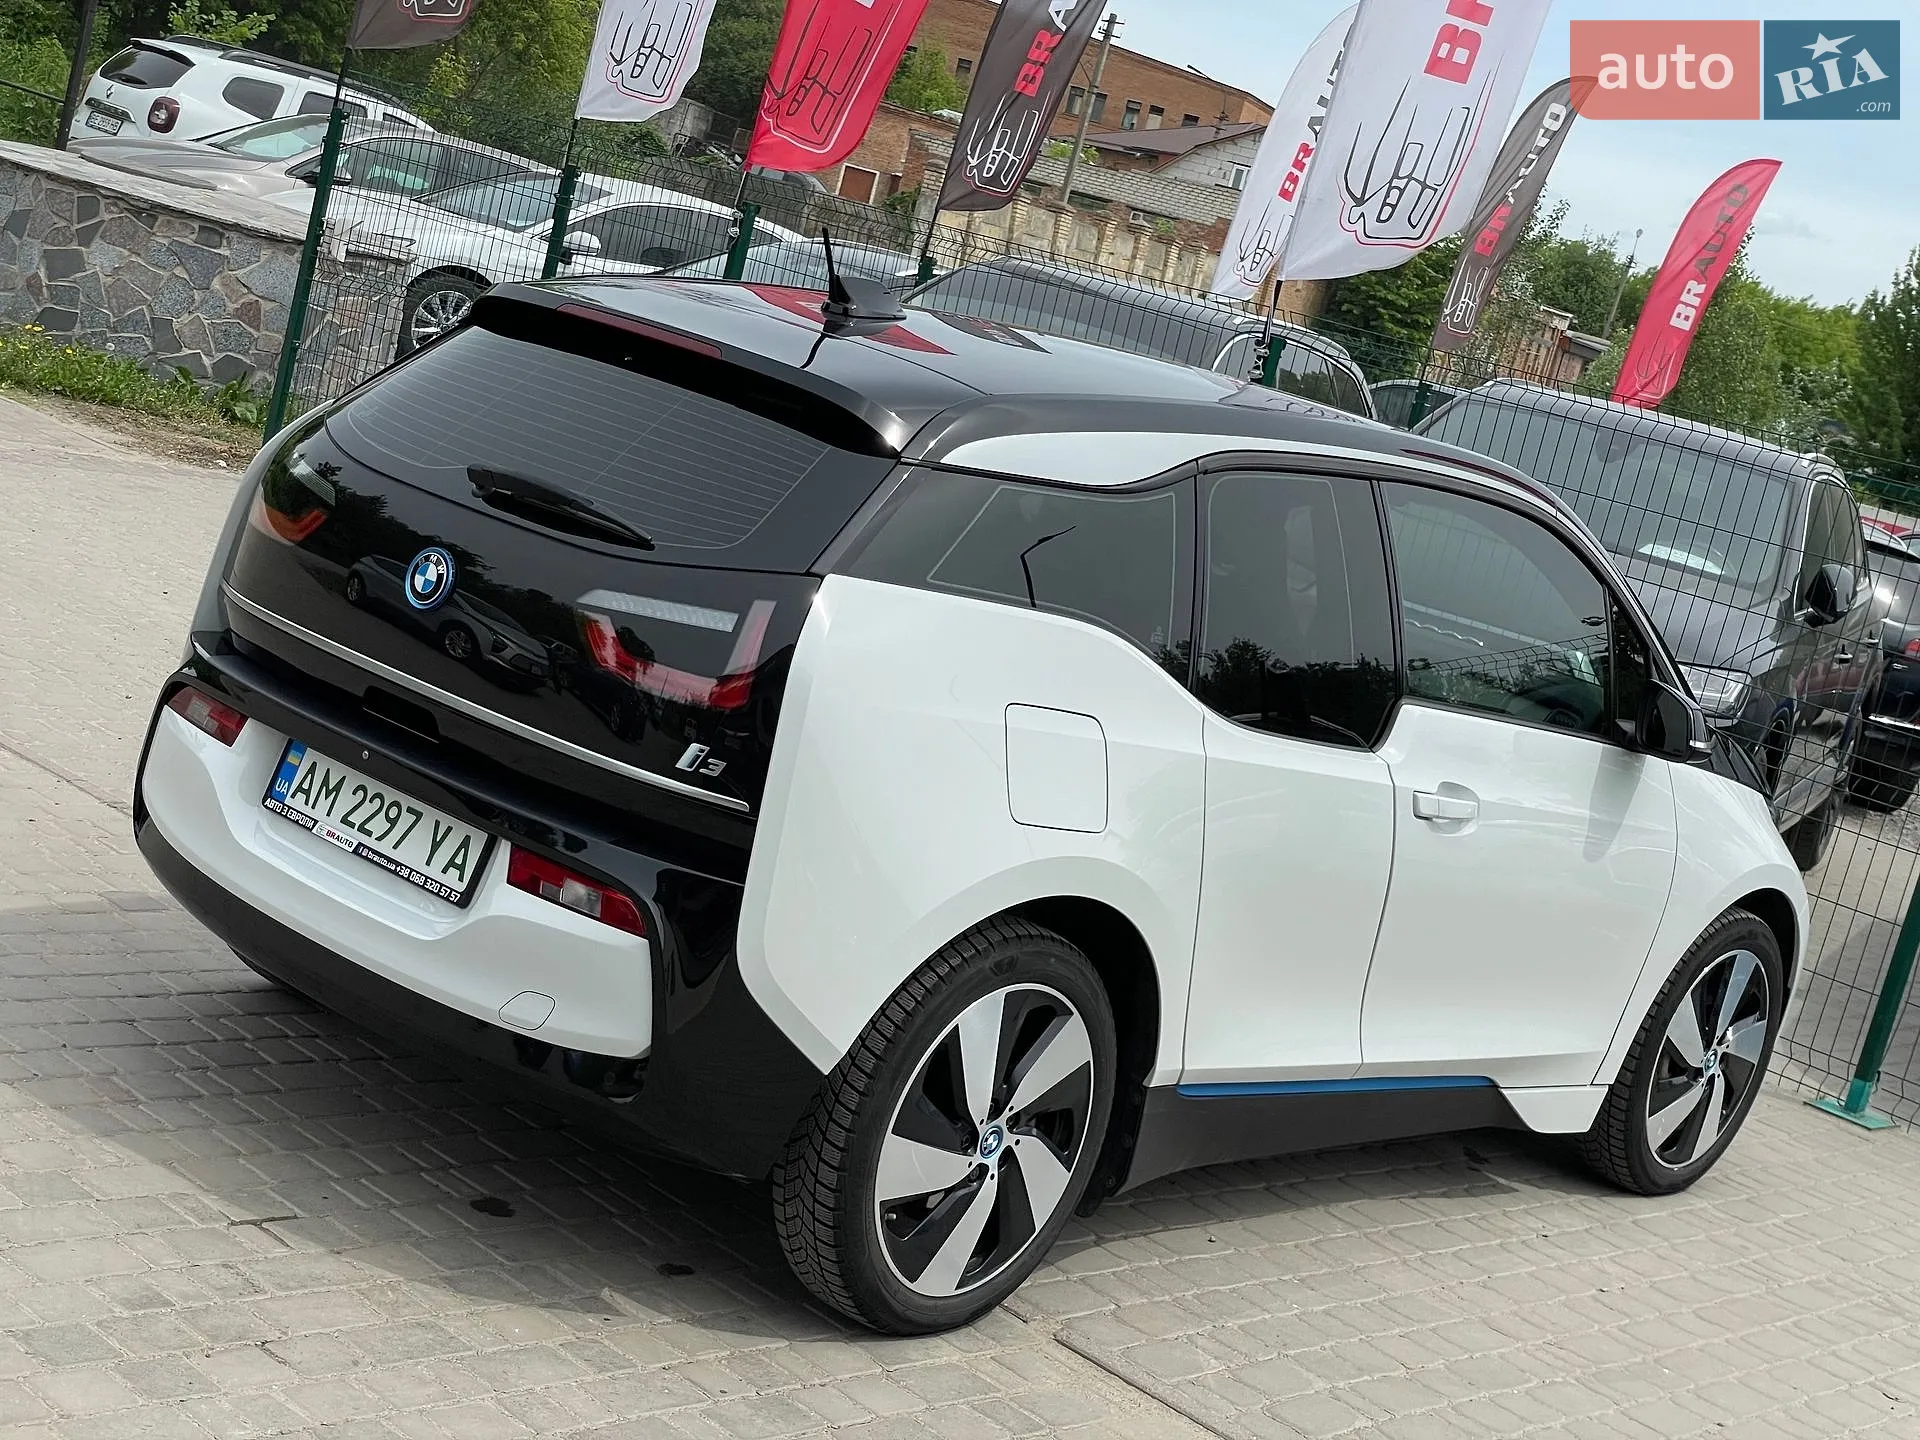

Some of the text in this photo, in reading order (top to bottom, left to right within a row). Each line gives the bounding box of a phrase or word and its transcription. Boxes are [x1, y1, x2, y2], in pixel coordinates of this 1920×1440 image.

[1669, 183, 1749, 332] BRAUTO
[674, 743, 728, 777] i3
[275, 778, 289, 795] UA
[290, 761, 472, 882] AM 2297 YA
[325, 829, 354, 849] BRAUTO
[396, 865, 411, 878] +38
[409, 871, 426, 886] 068
[424, 878, 441, 893] 320
[439, 886, 451, 898] 57
[449, 891, 461, 903] 57
